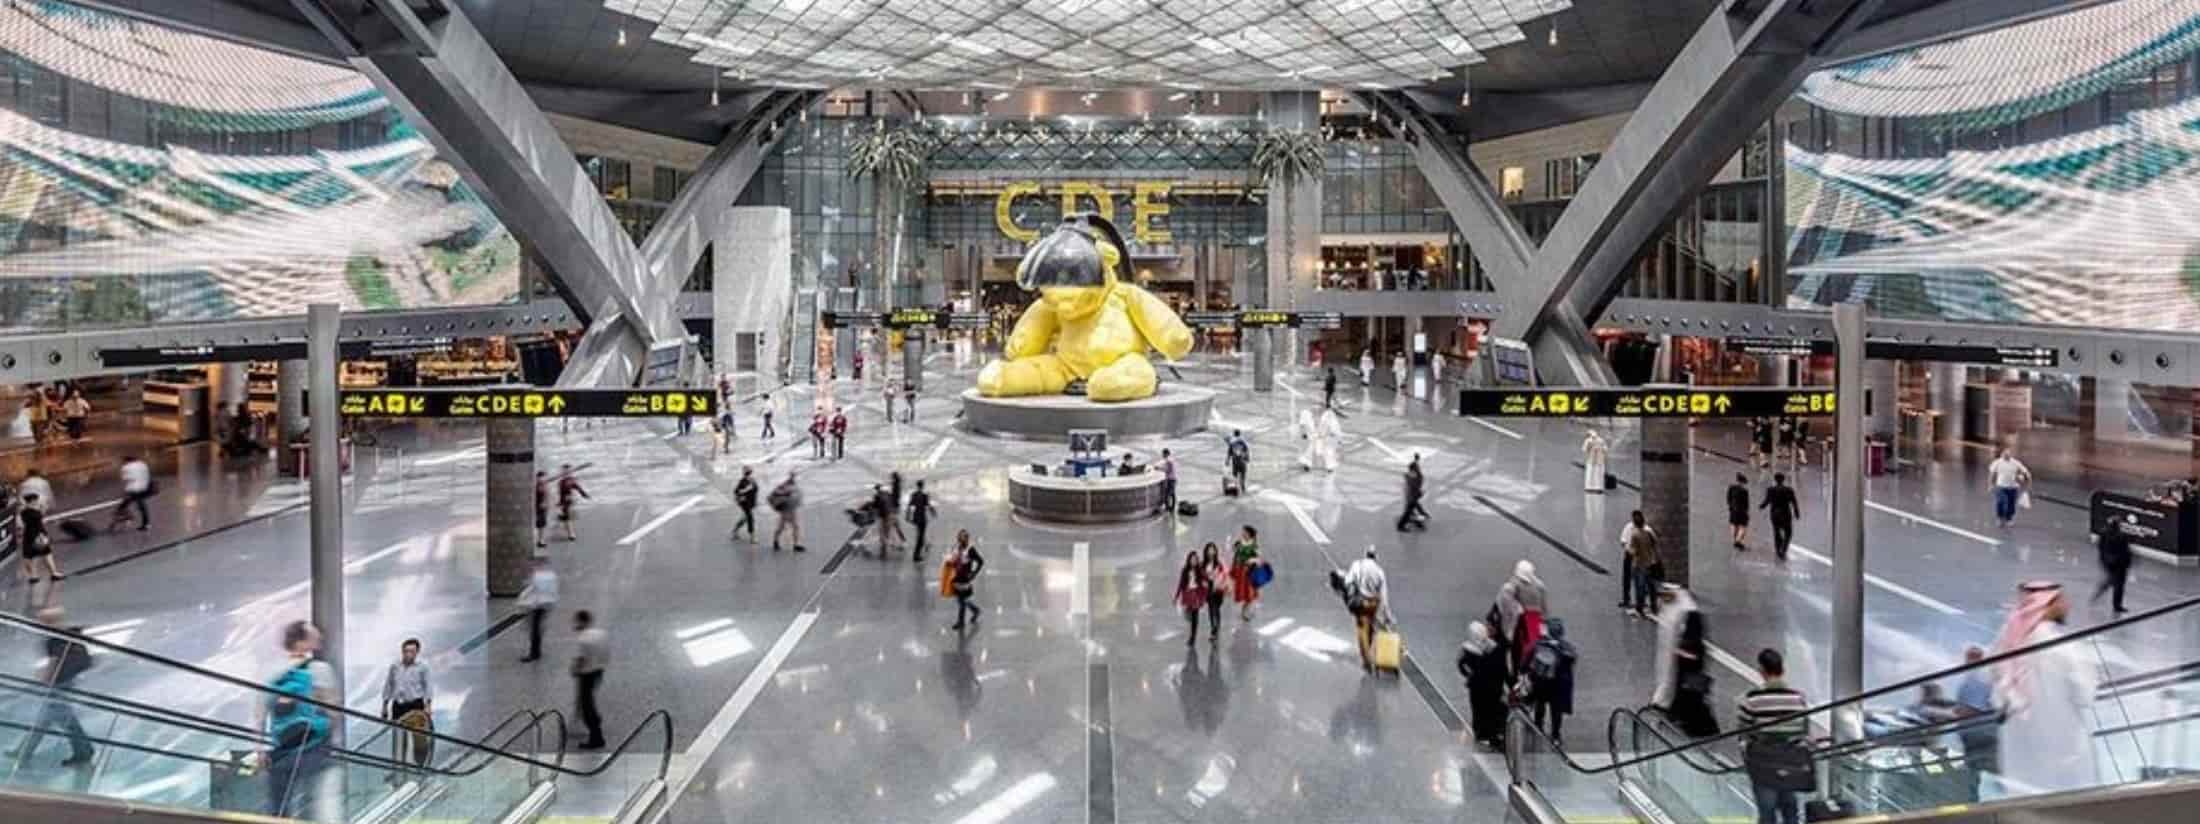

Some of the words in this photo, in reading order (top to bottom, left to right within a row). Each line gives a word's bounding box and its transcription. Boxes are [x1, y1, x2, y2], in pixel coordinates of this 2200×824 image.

[368, 395, 383, 412] A
[476, 395, 521, 413] CDE
[651, 395, 664, 412] B
[1530, 395, 1546, 412] A
[1643, 395, 1688, 413] CDE
[1810, 395, 1822, 412] B
